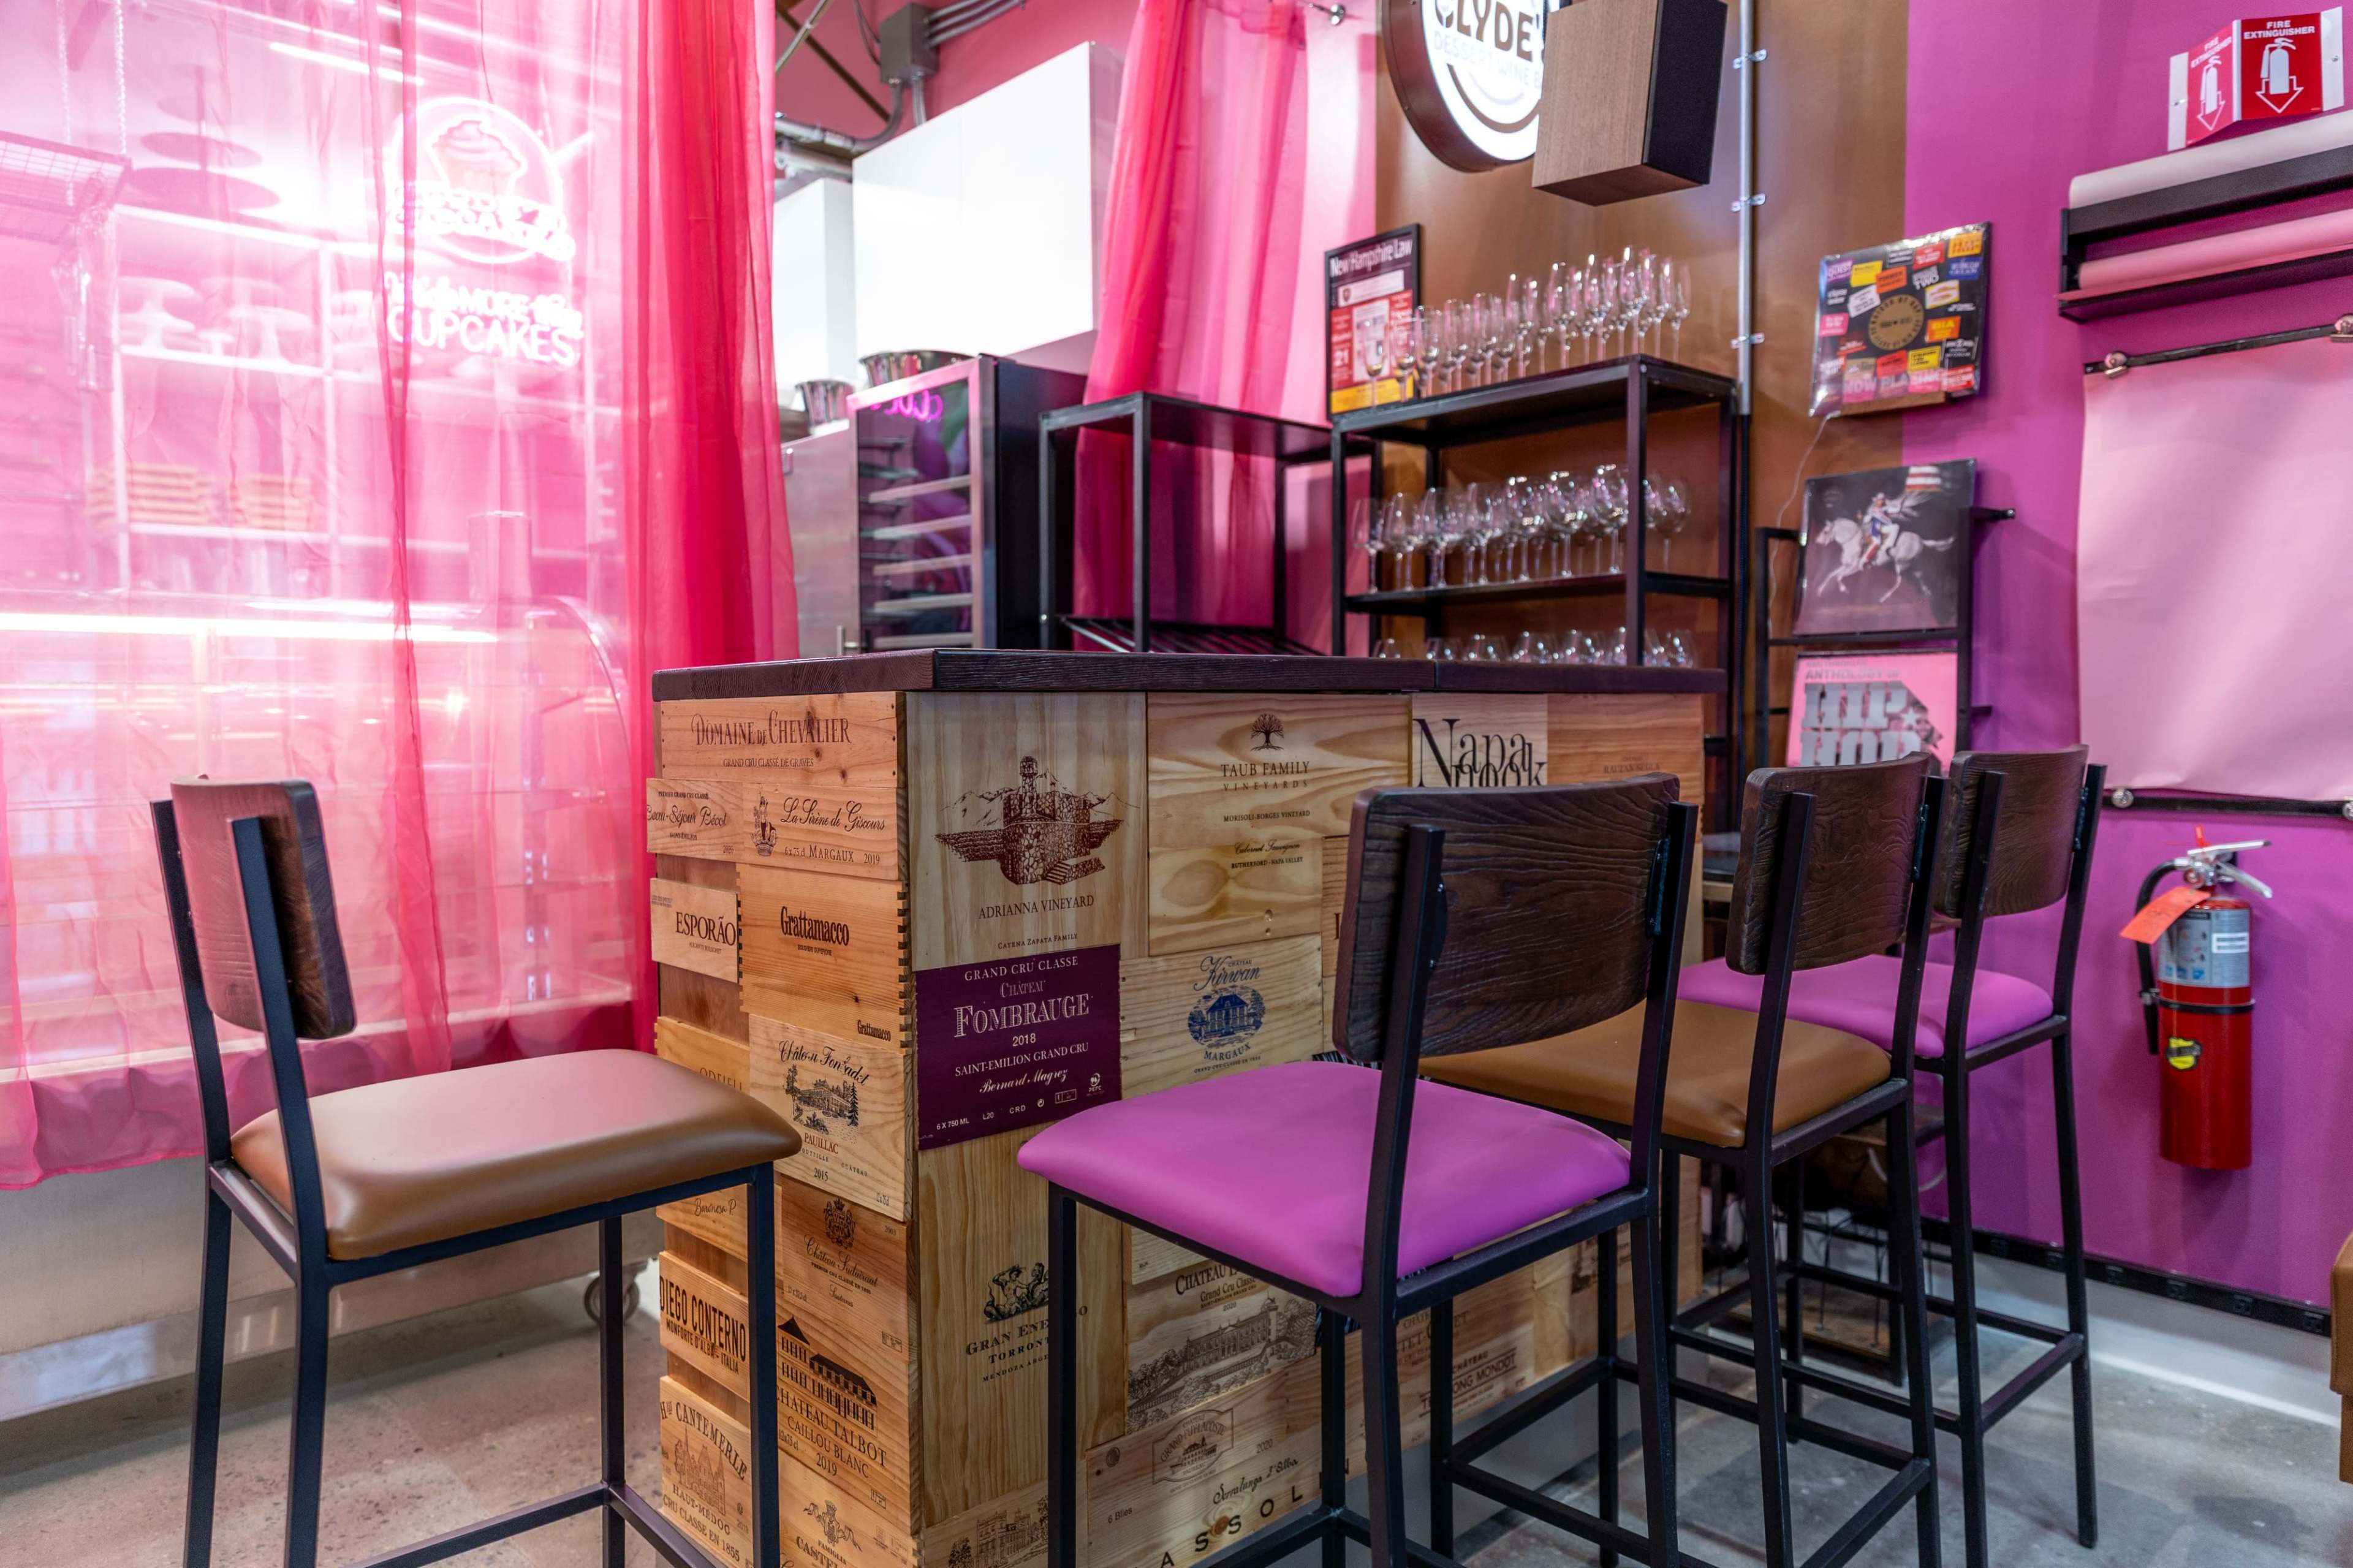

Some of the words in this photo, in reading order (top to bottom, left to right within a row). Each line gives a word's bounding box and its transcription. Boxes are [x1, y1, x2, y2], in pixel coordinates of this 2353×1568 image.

[2244, 26, 2315, 39] EXTINGUISHER
[2267, 20, 2290, 29] FIRE
[1330, 256, 1349, 278] New
[1350, 243, 1393, 271] Hampshire
[1393, 238, 1413, 259] Law
[387, 305, 576, 367] CUPCAKES
[768, 709, 852, 744] CHEVALIER
[723, 758, 744, 767] GRAND
[745, 758, 757, 767] CRU
[758, 756, 780, 767] CLASSÉ
[781, 758, 789, 767] DE
[790, 758, 814, 767] GRAVES
[1220, 763, 1257, 778] TAUB
[1263, 760, 1310, 776] FAMILY
[1223, 779, 1308, 792] VINEYARDS
[781, 797, 799, 823] La
[799, 798, 828, 825] Sirène
[830, 808, 841, 827] de
[844, 800, 885, 832] Giscours
[1281, 809, 1311, 819] VINEYARD
[809, 845, 854, 863] MARGAUX
[863, 853, 881, 865] 2019
[1235, 841, 1265, 855] Cabernet
[1230, 860, 1268, 869] RUTHERFORD
[979, 901, 1039, 919] ADRIANNA
[1041, 894, 1095, 912] VINEYARD
[675, 911, 736, 946] ESPORÃO
[781, 906, 850, 946] Grattamacco
[998, 941, 1026, 950] CATENA
[1027, 937, 1053, 946] ZAPATA
[1053, 933, 1078, 942] FAMILY
[964, 965, 1007, 981] GRAND
[1011, 961, 1034, 975] CRU
[1193, 955, 1260, 991] Kirwan
[953, 993, 1089, 1037] FOMBRAUGE
[857, 1019, 892, 1042] Grattamacco
[1012, 1033, 1037, 1047] 2018
[1034, 1046, 1068, 1062] GRAND
[1070, 1042, 1089, 1054] CRU
[1203, 1042, 1252, 1061] MARGAUX
[979, 1073, 1028, 1093] Bernard
[1028, 1068, 1069, 1087] Magrez
[982, 1111, 995, 1120] L20
[1009, 1104, 1026, 1115] CRD
[947, 1119, 959, 1128] 750
[804, 1132, 839, 1154] PAUILLAC
[813, 1167, 828, 1183] 2015
[694, 1198, 727, 1217] Baronesa
[1200, 1286, 1221, 1301] Grand
[1222, 1282, 1235, 1294] Cru
[659, 1275, 688, 1326] DIEGO
[692, 1294, 746, 1362] CONTERNO
[666, 1317, 692, 1346] MONFORTE
[721, 1352, 739, 1375] ITALIA
[966, 1331, 1012, 1356] GRAN
[982, 1363, 1025, 1383] MENDOZA
[1476, 1352, 1517, 1381] MONDOT
[676, 1401, 748, 1481] CANTEMERLE
[787, 1415, 831, 1453] CAILLOU
[833, 1444, 869, 1478] BLANC
[832, 1418, 887, 1467] TALBOT
[1256, 1437, 1273, 1454] 2020
[816, 1452, 837, 1476] 2019
[1213, 1475, 1263, 1505] Serralunga
[663, 1493, 678, 1513] CRU
[709, 1529, 719, 1547] EN
[722, 1539, 740, 1562] 1855
[1107, 1514, 1113, 1524] 6
